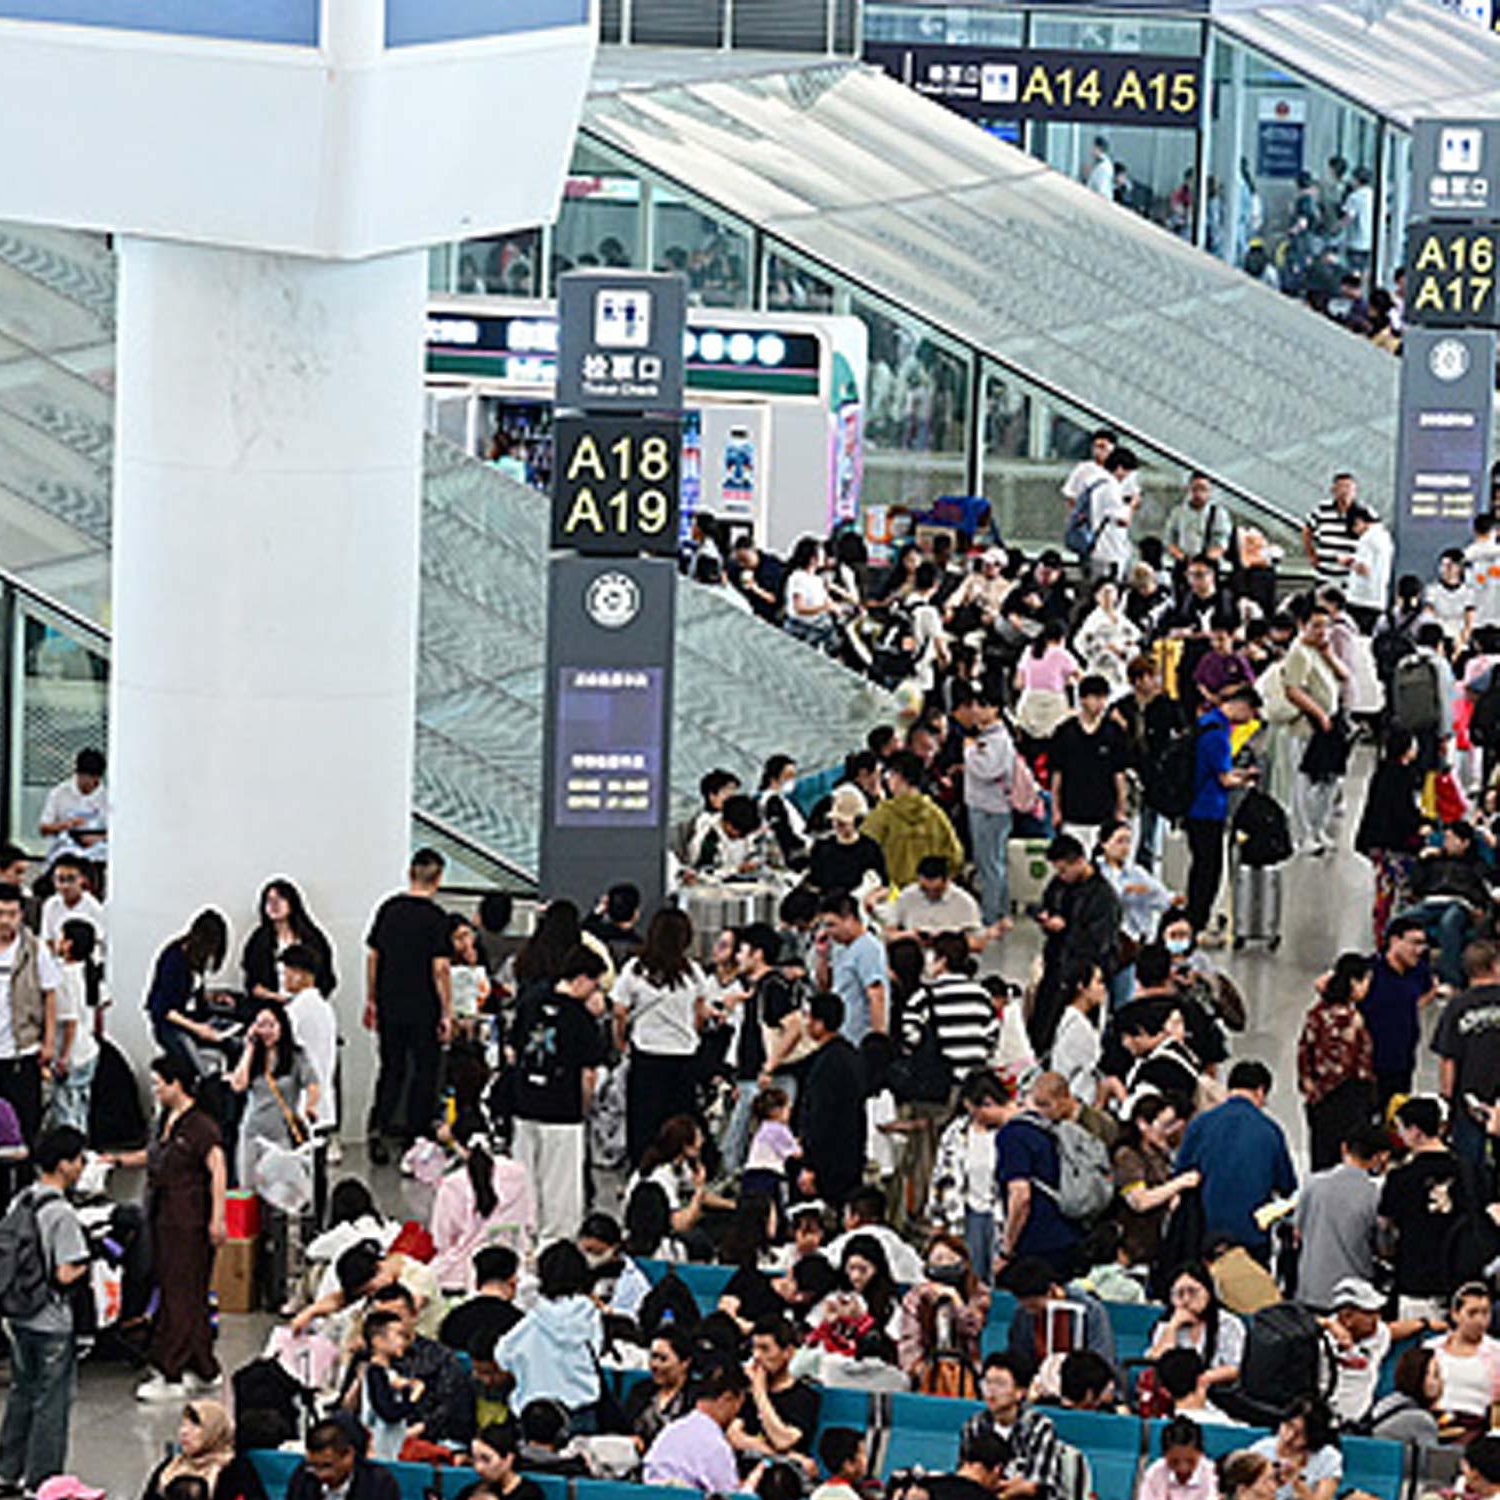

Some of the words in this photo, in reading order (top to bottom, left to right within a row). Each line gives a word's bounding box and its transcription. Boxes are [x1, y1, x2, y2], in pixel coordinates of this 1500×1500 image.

[1022, 66, 1100, 106] A14
[1113, 71, 1195, 112] A15
[1416, 236, 1493, 273] A16
[1415, 275, 1493, 312] A17
[567, 437, 669, 481] A18
[565, 490, 668, 534] A19
